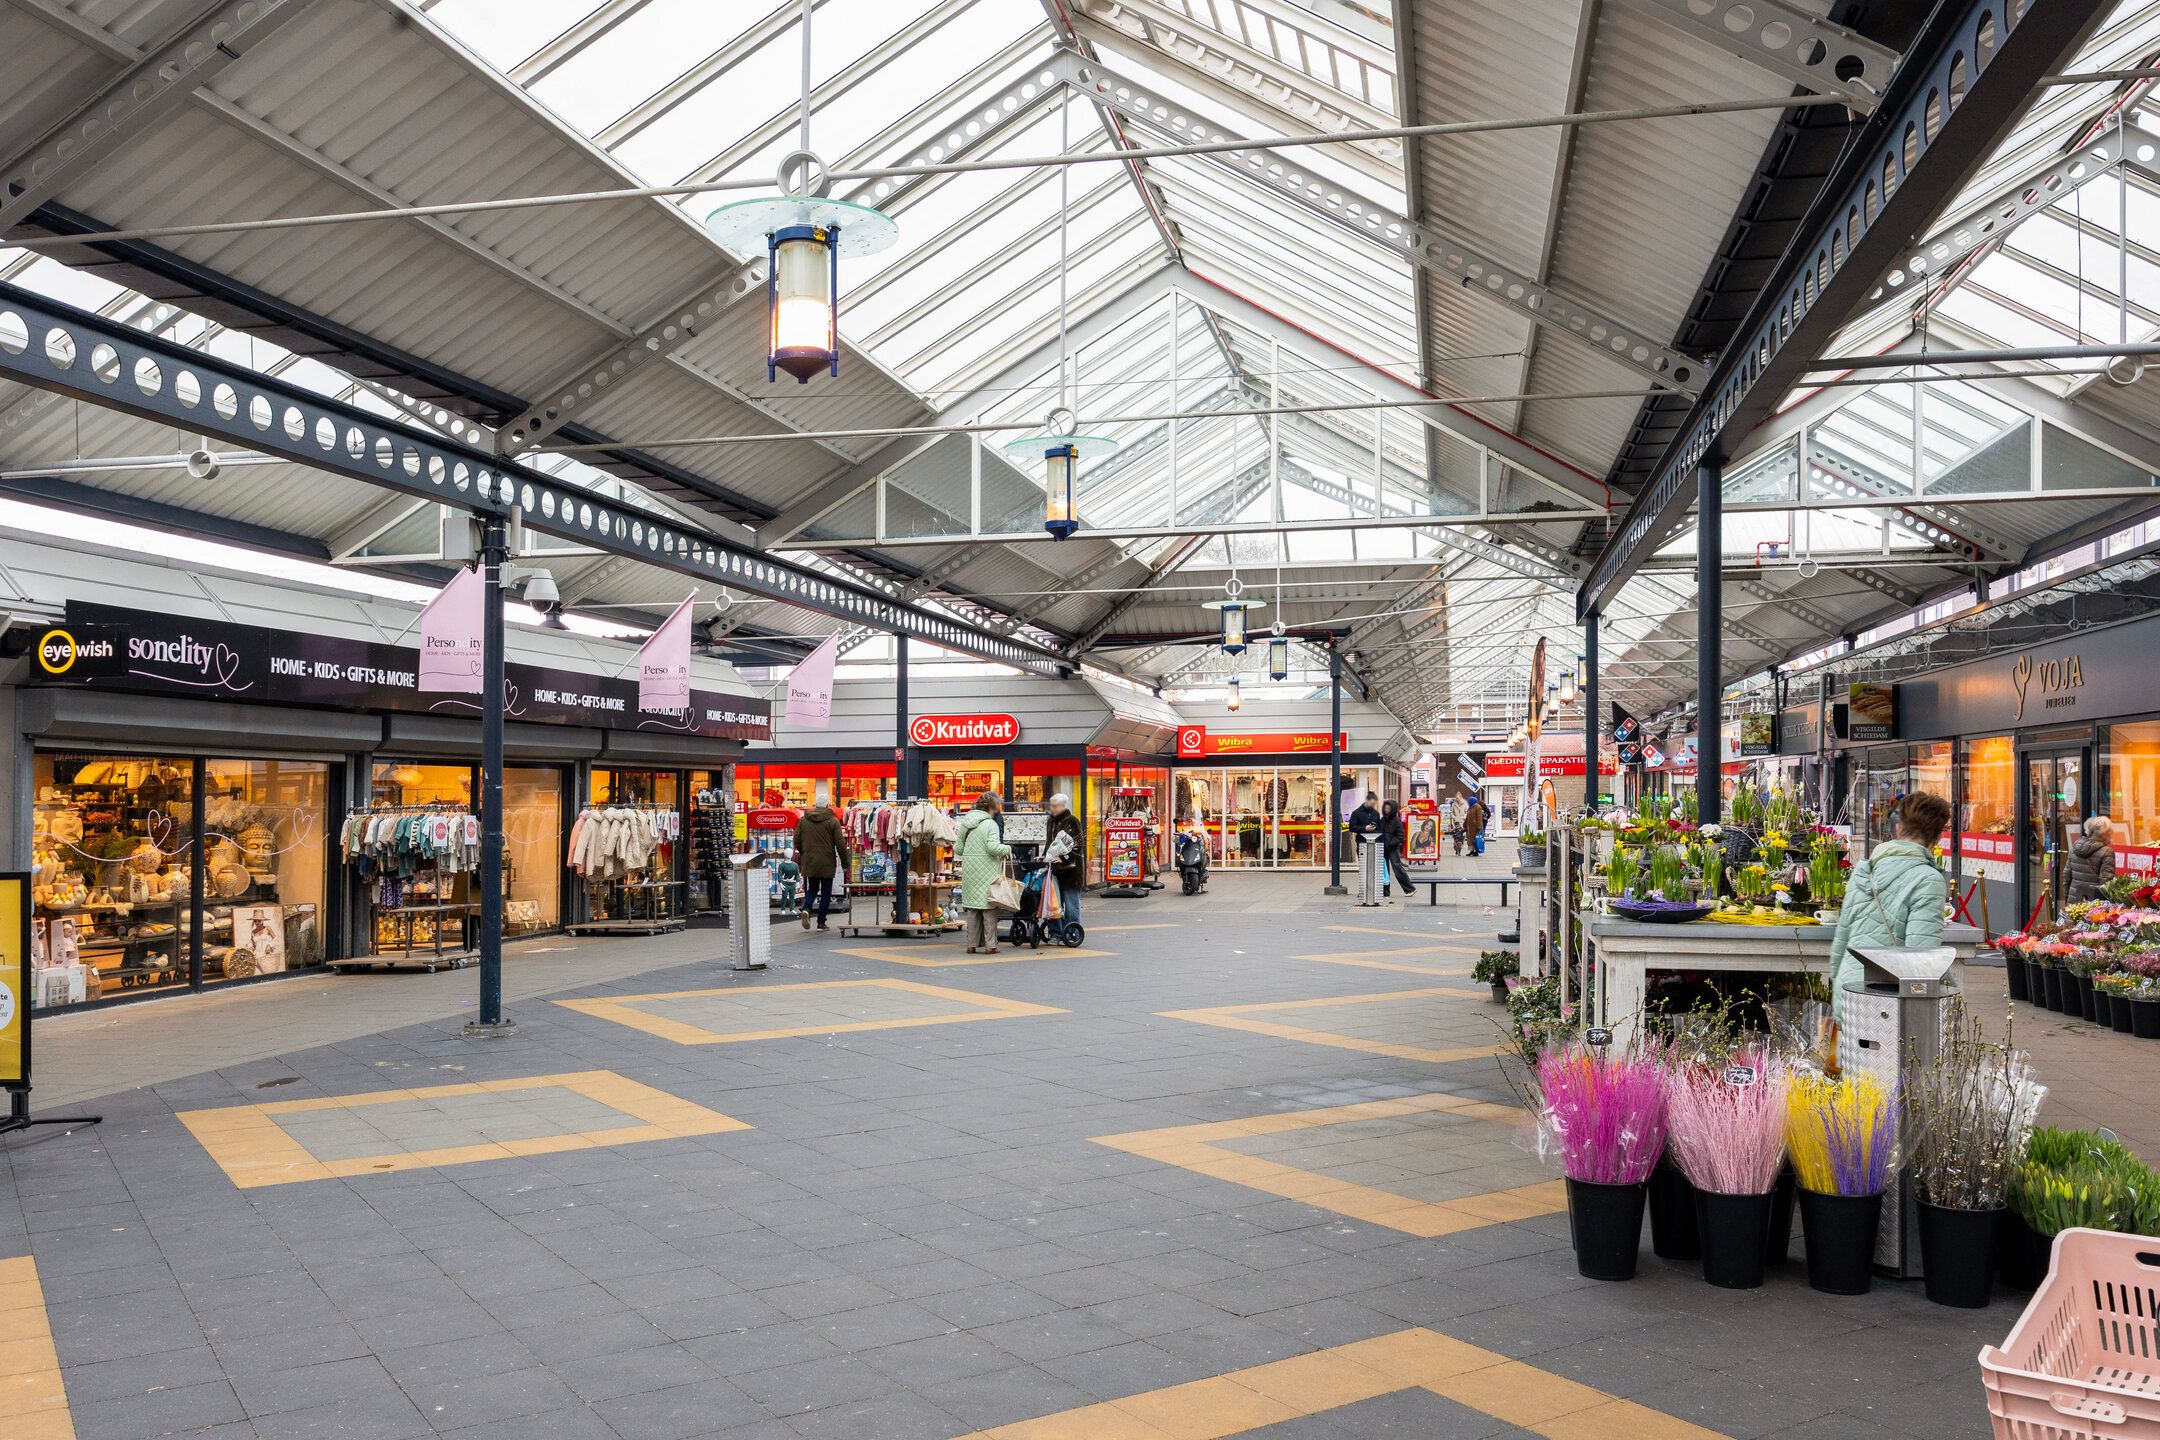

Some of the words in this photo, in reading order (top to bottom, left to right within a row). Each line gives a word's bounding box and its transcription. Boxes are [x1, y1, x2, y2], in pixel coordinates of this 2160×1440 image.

[270, 657, 307, 676] HOME
[314, 661, 340, 680] KIDS
[347, 666, 376, 683] GIFTS
[377, 669, 386, 685] &
[387, 670, 415, 688] MORE
[2036, 655, 2085, 693] VOJA
[534, 688, 557, 704] HOME
[561, 692, 578, 706] KIDS
[582, 694, 600, 709] GIFTS
[600, 697, 607, 709] &
[606, 698, 625, 712] MORE
[706, 709, 722, 722] HOME
[724, 711, 736, 723] KIDS
[738, 713, 751, 725] GIFTS
[755, 715, 768, 727] MORE
[937, 719, 1012, 739] Kruidvat
[1217, 736, 1253, 746] Wibra
[1293, 734, 1329, 745] Wibra
[1115, 819, 1141, 827] Kruidvat
